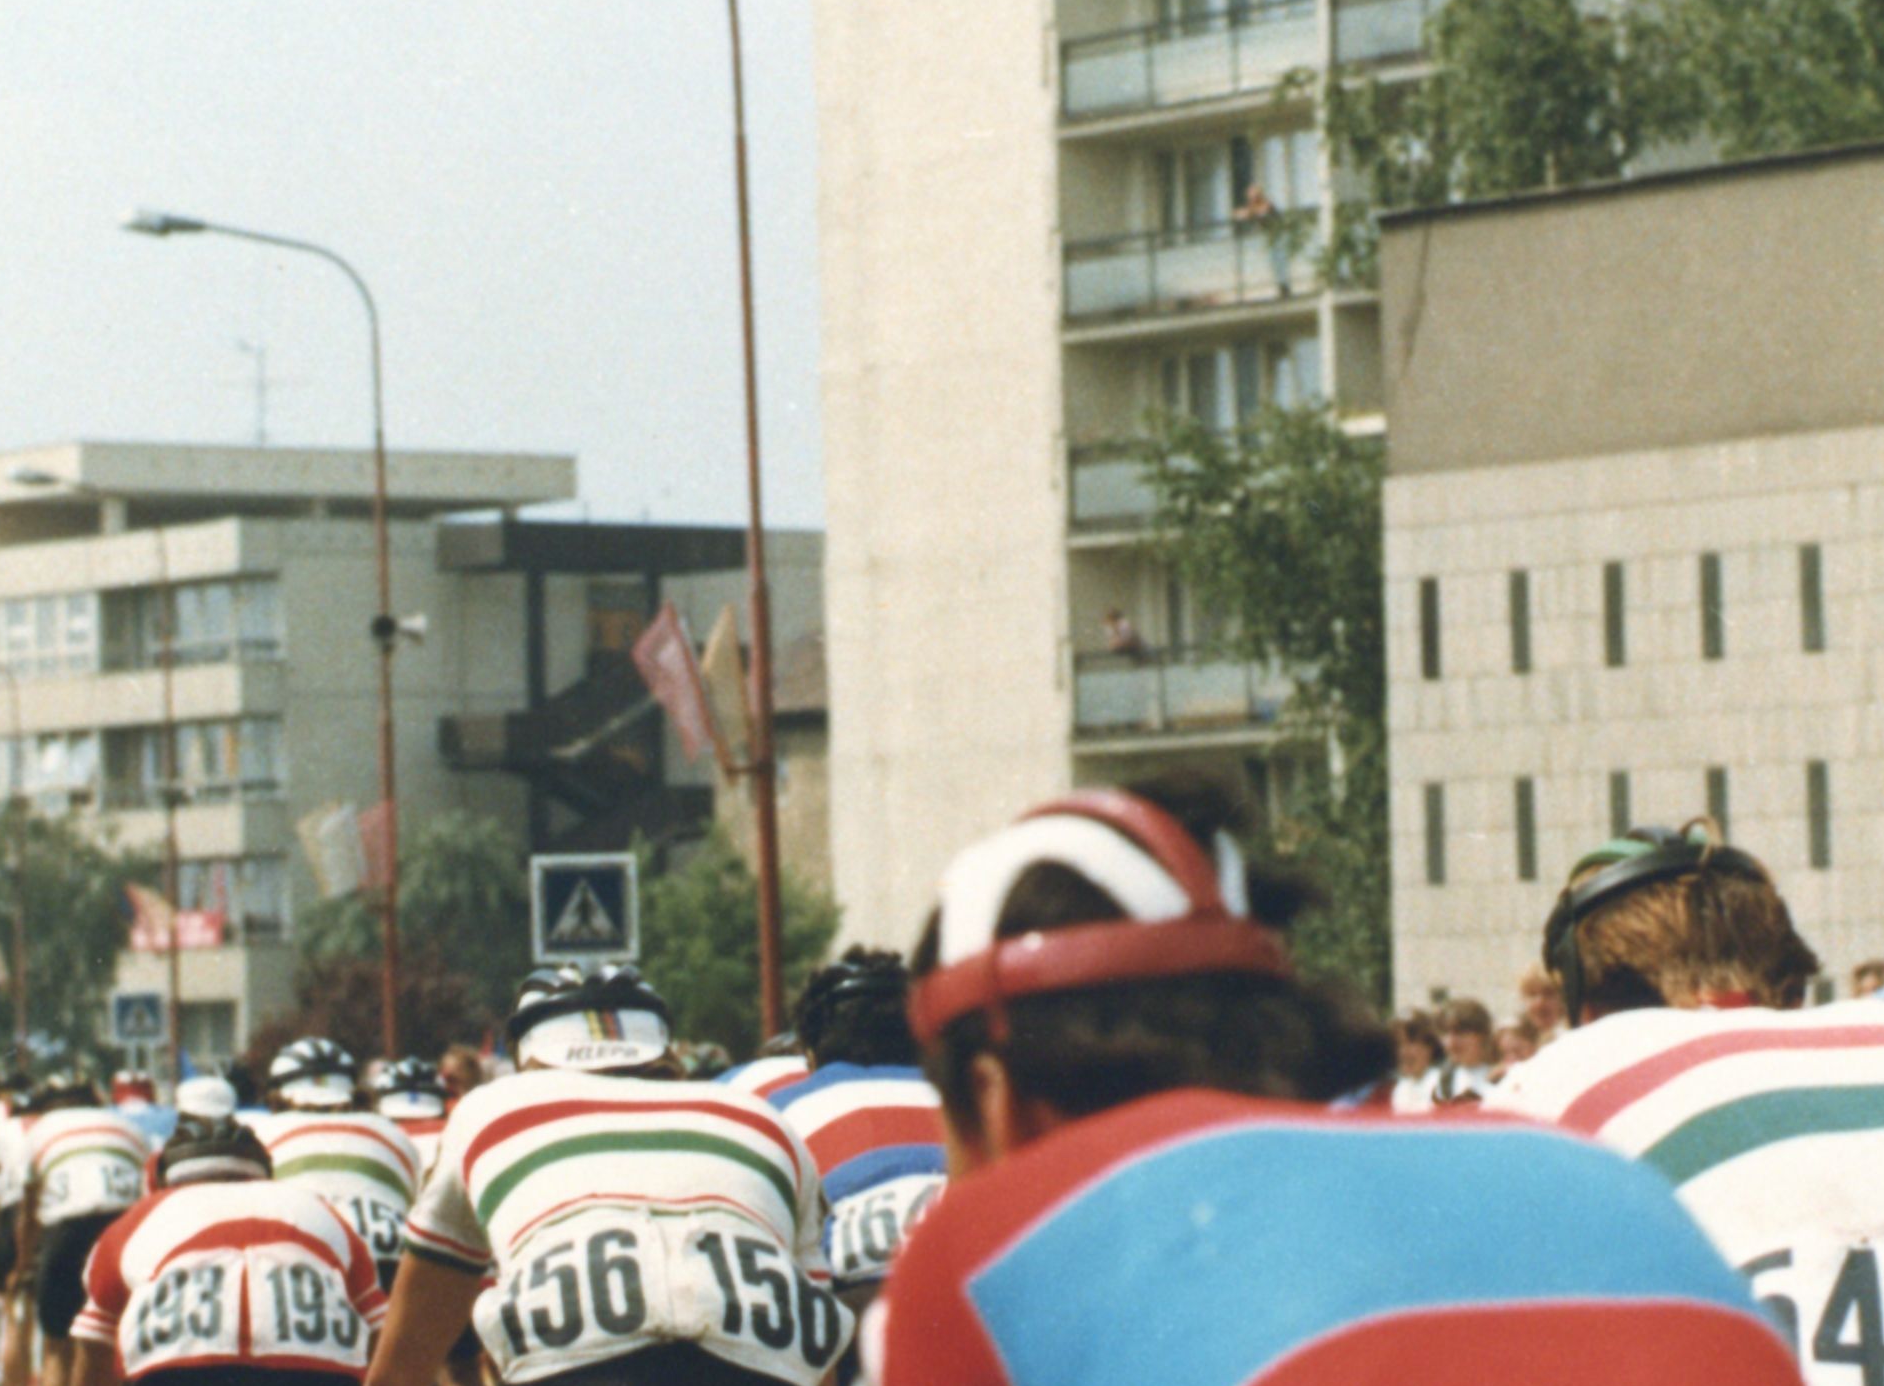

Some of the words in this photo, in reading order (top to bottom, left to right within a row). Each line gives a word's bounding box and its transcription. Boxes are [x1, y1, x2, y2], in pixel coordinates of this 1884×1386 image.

[349, 1196, 406, 1253] 15
[136, 1264, 226, 1354] 193
[266, 1261, 360, 1349] 193
[500, 1227, 647, 1356] 156
